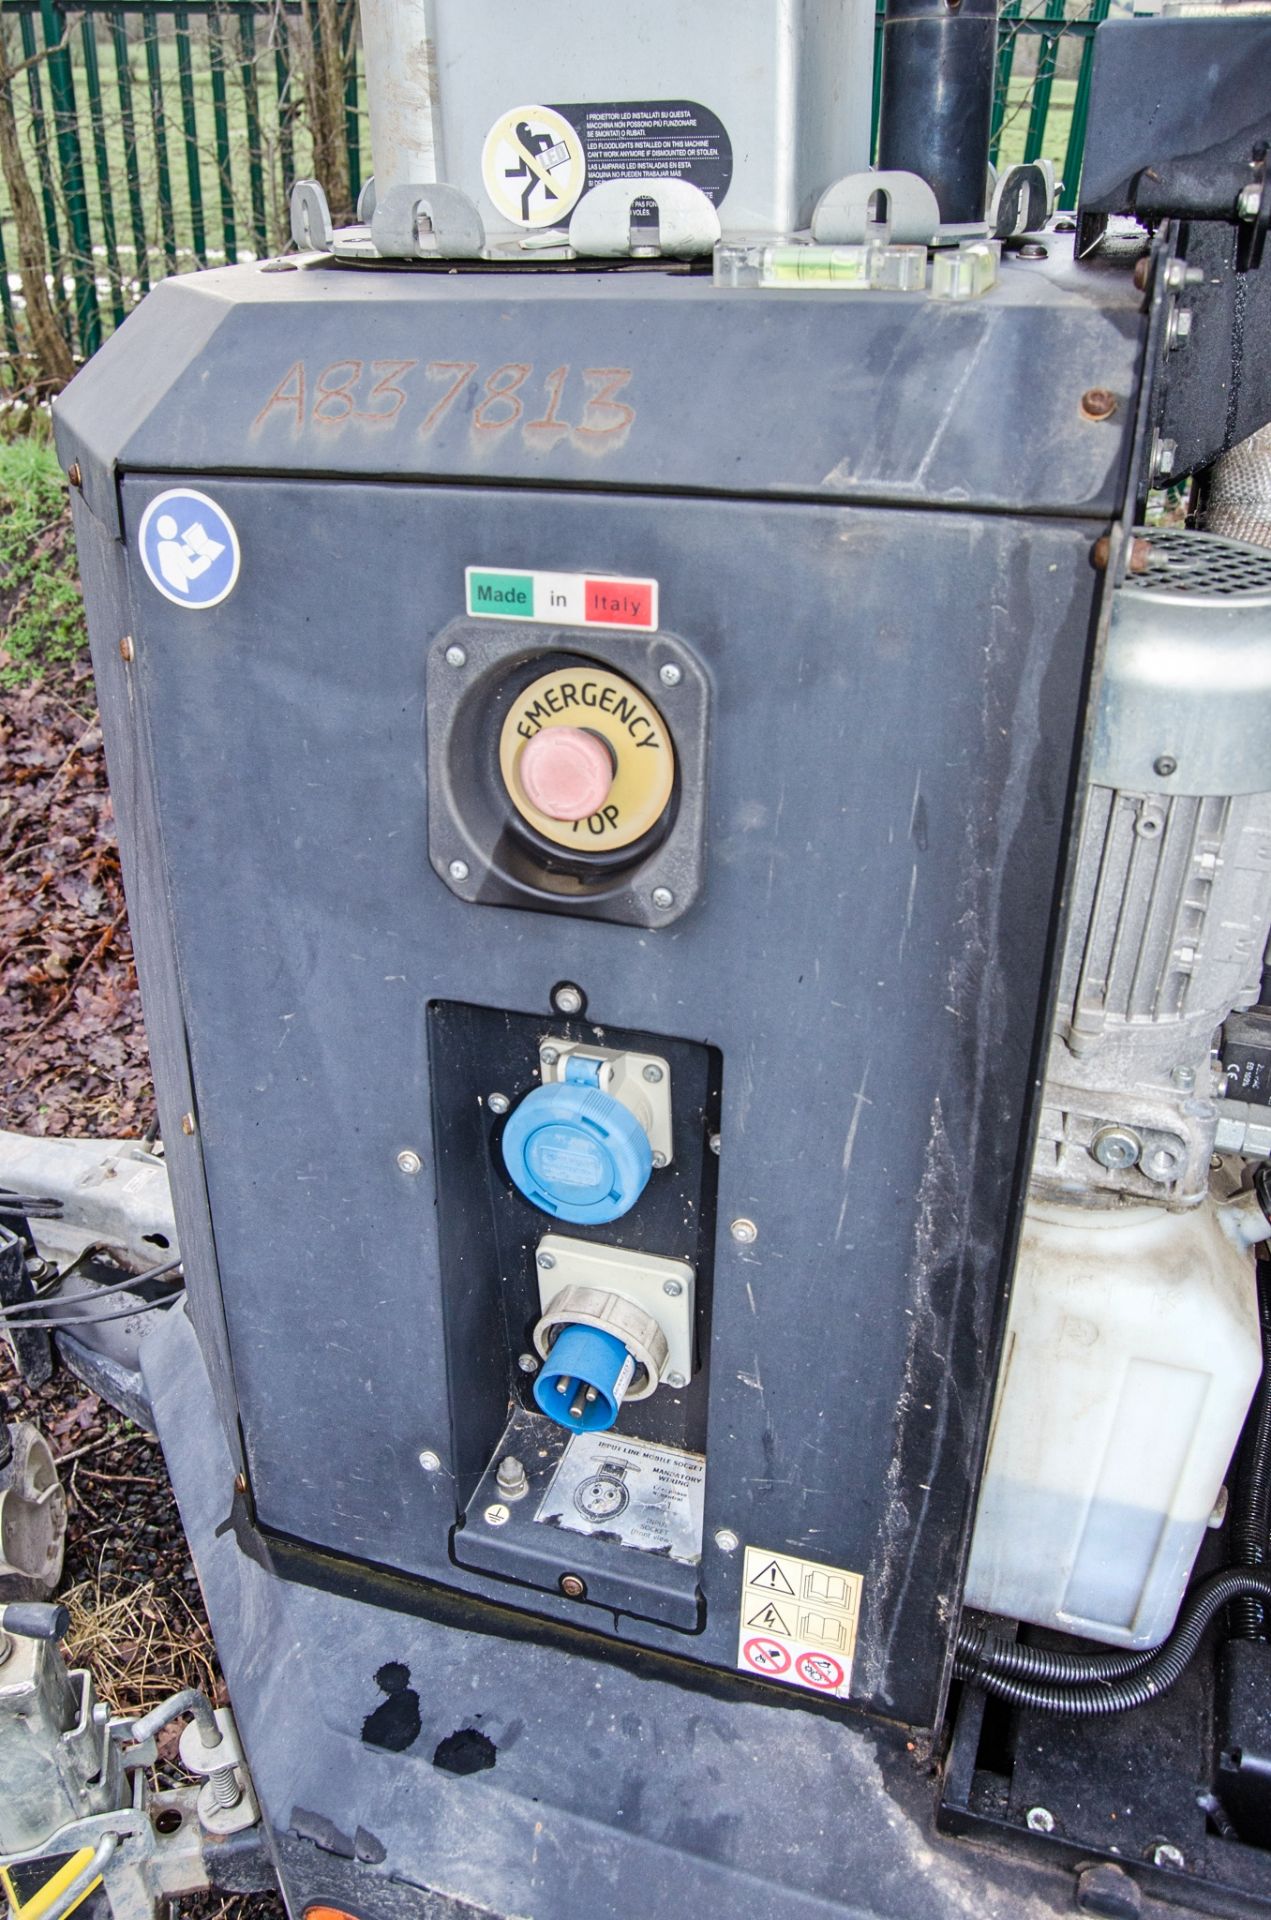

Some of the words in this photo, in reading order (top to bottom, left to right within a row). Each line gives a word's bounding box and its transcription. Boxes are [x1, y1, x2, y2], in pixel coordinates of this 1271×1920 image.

[589, 113, 620, 121] PROIETTORI
[620, 112, 631, 120] LED
[631, 111, 660, 120] INSTALLATI
[660, 111, 668, 119] SU
[669, 110, 691, 118] QUESTA
[586, 121, 613, 129] MACCHINA
[626, 120, 652, 129] POSSONO
[662, 119, 697, 127] FUNZIONARE
[594, 129, 620, 138] SMONTATI
[586, 141, 598, 150] LED
[597, 141, 634, 149] FLOODLIGHTS
[634, 140, 662, 149] INSTALLED
[662, 140, 671, 148] ON
[672, 139, 684, 148] THIS
[684, 139, 709, 147] MACHINE
[603, 149, 620, 158] WORK
[620, 149, 646, 158] ANYMORE
[645, 148, 652, 157] IF
[651, 148, 687, 157] DISMOUNTED
[687, 147, 696, 156] OR
[696, 147, 719, 156] STOLEN.
[587, 162, 598, 170] LAS
[626, 161, 637, 170] LED
[636, 161, 669, 169] INSTALADAS
[668, 160, 678, 169] EN
[677, 160, 692, 169] ESTA
[611, 170, 621, 178] NO
[620, 169, 643, 178] PUEDEN
[642, 169, 669, 177] TRABAJAR
[250, 359, 637, 444] A837813
[477, 584, 527, 605] Made
[550, 590, 567, 607] in
[594, 594, 641, 616] Italy
[516, 682, 660, 750] EMERGENCY
[623, 1447, 640, 1457] LINE
[642, 1452, 671, 1465] MOBILE
[673, 1459, 703, 1472] SOCKET
[652, 1467, 702, 1484] MANDATORY
[658, 1475, 690, 1488] WIRING
[640, 1523, 671, 1536] SOCKET
